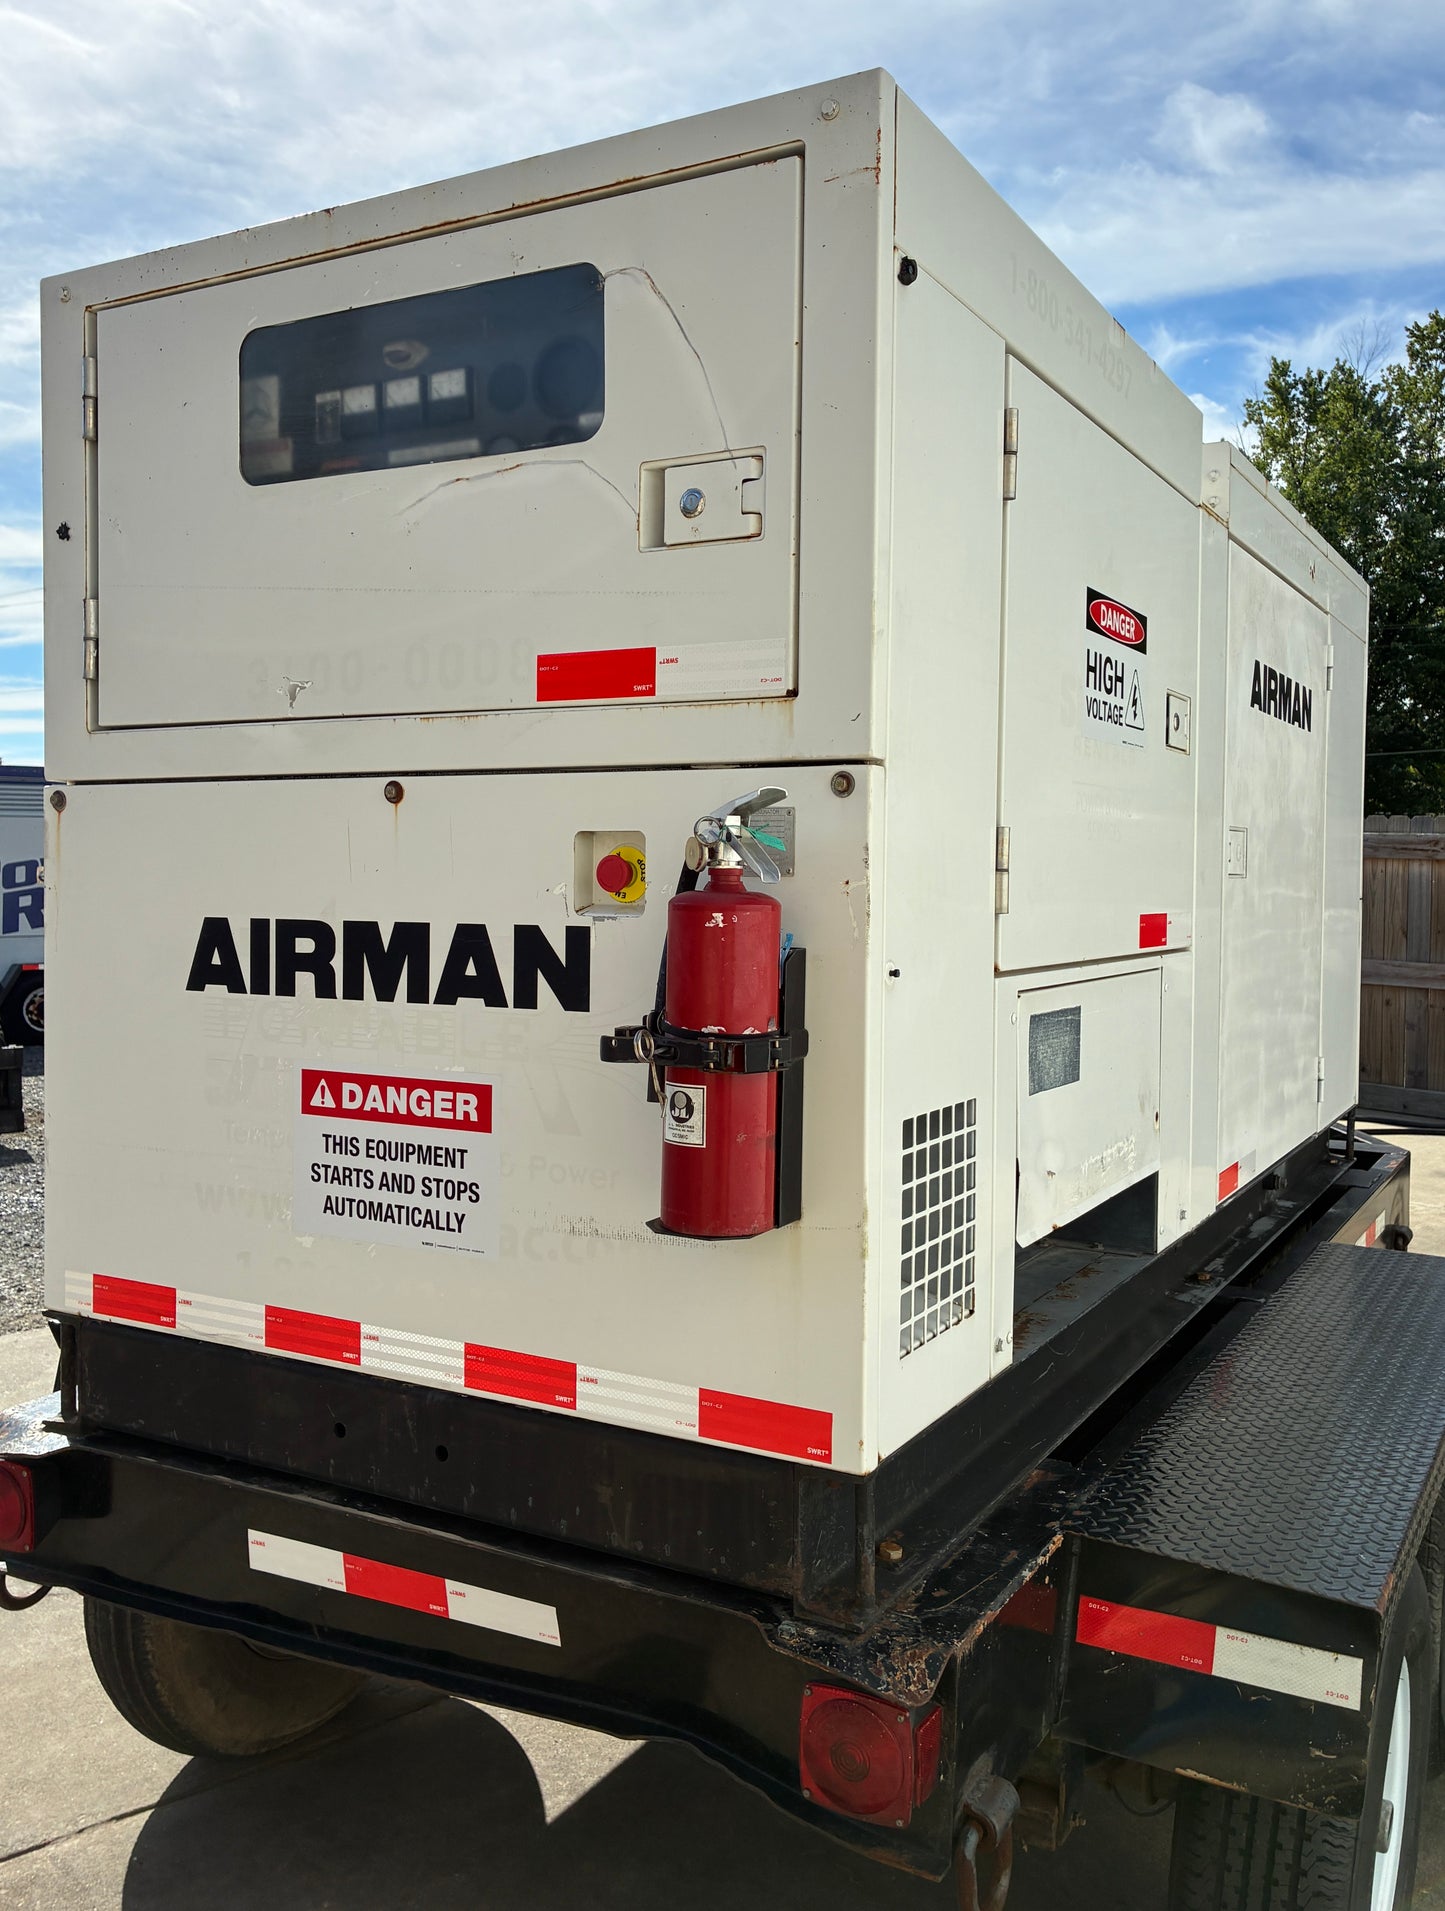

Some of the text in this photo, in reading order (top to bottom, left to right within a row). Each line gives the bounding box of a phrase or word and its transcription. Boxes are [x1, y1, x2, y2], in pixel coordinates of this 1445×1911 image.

[1100, 603, 1135, 640] DANGER
[1086, 648, 1125, 699] HIGH
[1086, 695, 1123, 727] VOLTAGE
[1250, 659, 1312, 733] AIRMAN
[185, 916, 591, 1012] AIRMAN
[341, 1082, 478, 1122] DANGER
[322, 1133, 468, 1169] THIS EQUIPMENT
[310, 1163, 480, 1203] STARTS AND STOPS
[528, 1154, 620, 1190] Power
[323, 1195, 466, 1233] AUTOMATICALLY
[1088, 1602, 1109, 1611] DOT-C2
[1226, 1634, 1249, 1644] DOT-C2
[1181, 1655, 1203, 1665] DOT-C2
[1325, 1690, 1349, 1700] DOT-C2
